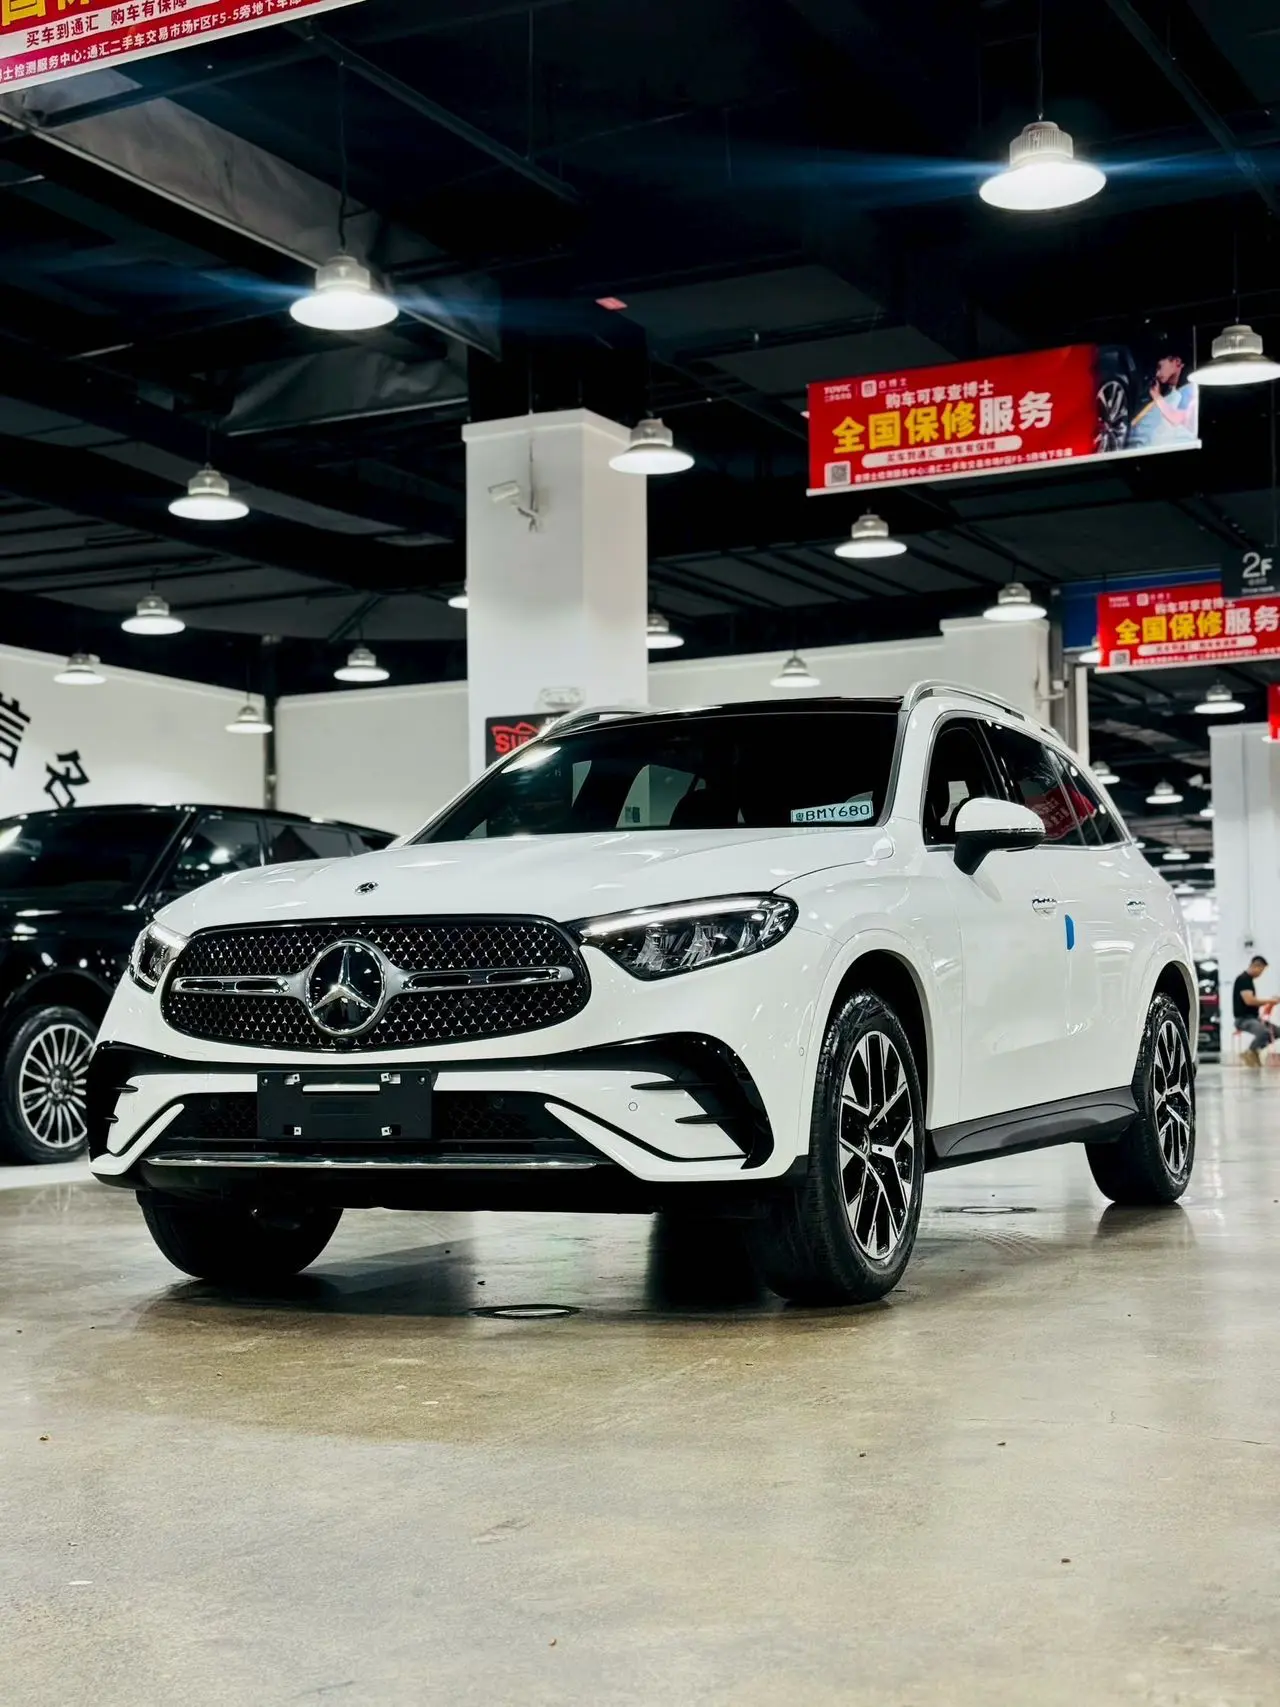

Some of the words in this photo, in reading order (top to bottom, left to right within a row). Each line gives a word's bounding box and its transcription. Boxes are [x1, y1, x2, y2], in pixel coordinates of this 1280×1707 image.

[26, 14, 99, 48] 买车到通汇
[110, 0, 188, 26] 购车有保障
[885, 379, 994, 409] 购车可享查博士
[832, 391, 1053, 454] 全国保修服务
[1242, 552, 1273, 578] 2F
[1115, 605, 1279, 645] 全国保修服务
